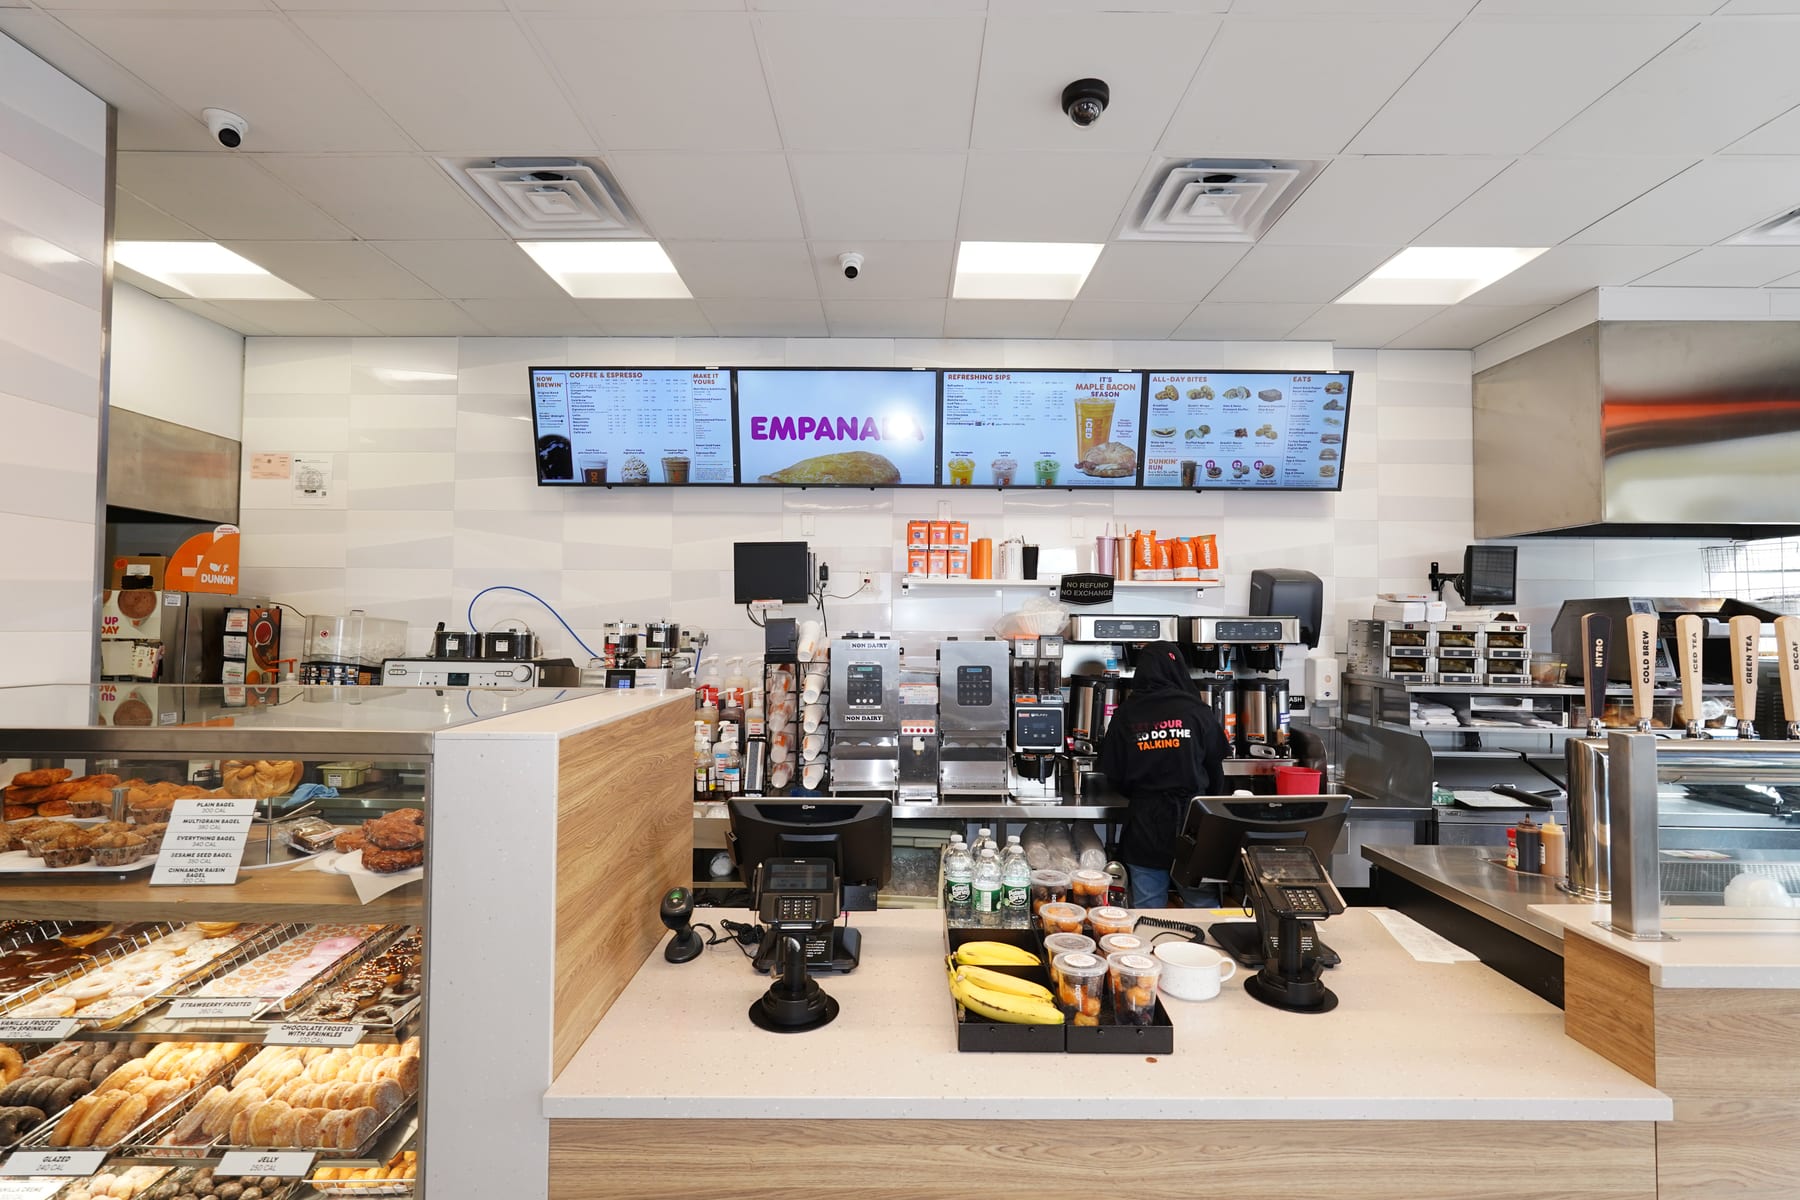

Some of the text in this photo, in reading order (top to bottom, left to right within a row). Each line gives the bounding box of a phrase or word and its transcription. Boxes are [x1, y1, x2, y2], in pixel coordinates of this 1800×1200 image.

[751, 416, 925, 441] EMPANA
[104, 616, 119, 625] UP
[1642, 630, 1650, 656] BREW
[1594, 638, 1604, 668] NITRO
[1792, 641, 1800, 671] DECAF
[1151, 730, 1168, 739] DO
[1169, 729, 1191, 738] THE
[1137, 738, 1180, 751] TALKING
[42, 1155, 71, 1163] GLAZED
